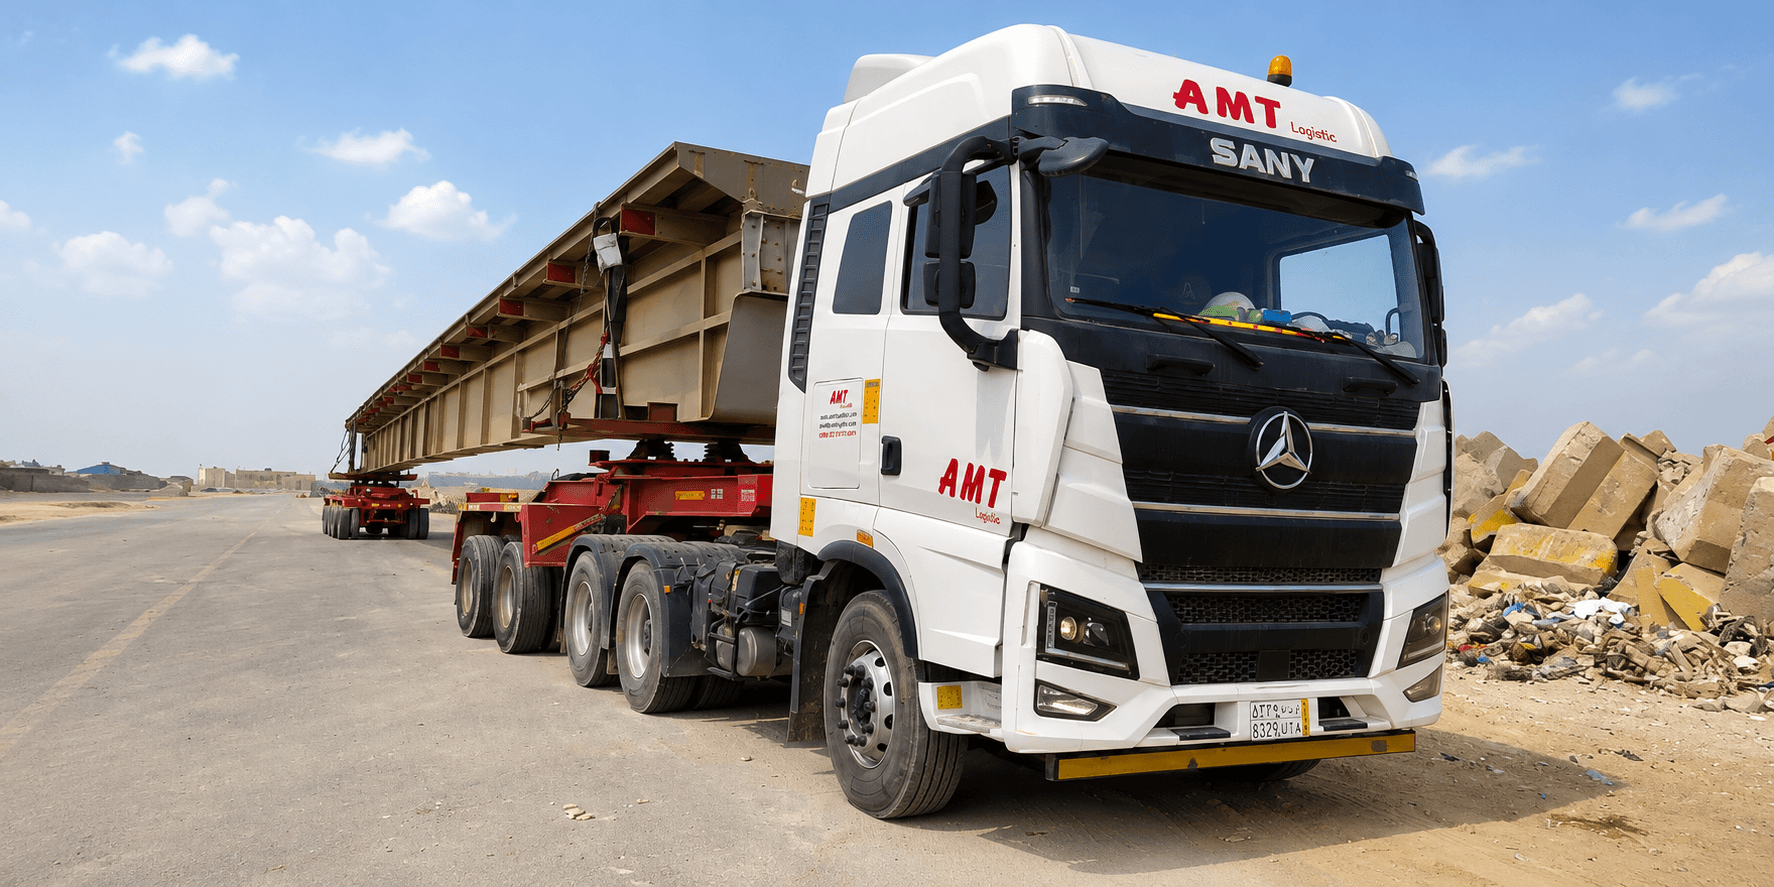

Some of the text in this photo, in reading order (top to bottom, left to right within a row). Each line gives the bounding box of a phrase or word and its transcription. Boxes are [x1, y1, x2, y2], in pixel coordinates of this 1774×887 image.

[1172, 78, 1281, 129] AMT
[1290, 121, 1337, 143] Logistic
[1209, 137, 1315, 183] SANY
[938, 458, 1007, 509] AMT
[1252, 721, 1279, 739] 8329
